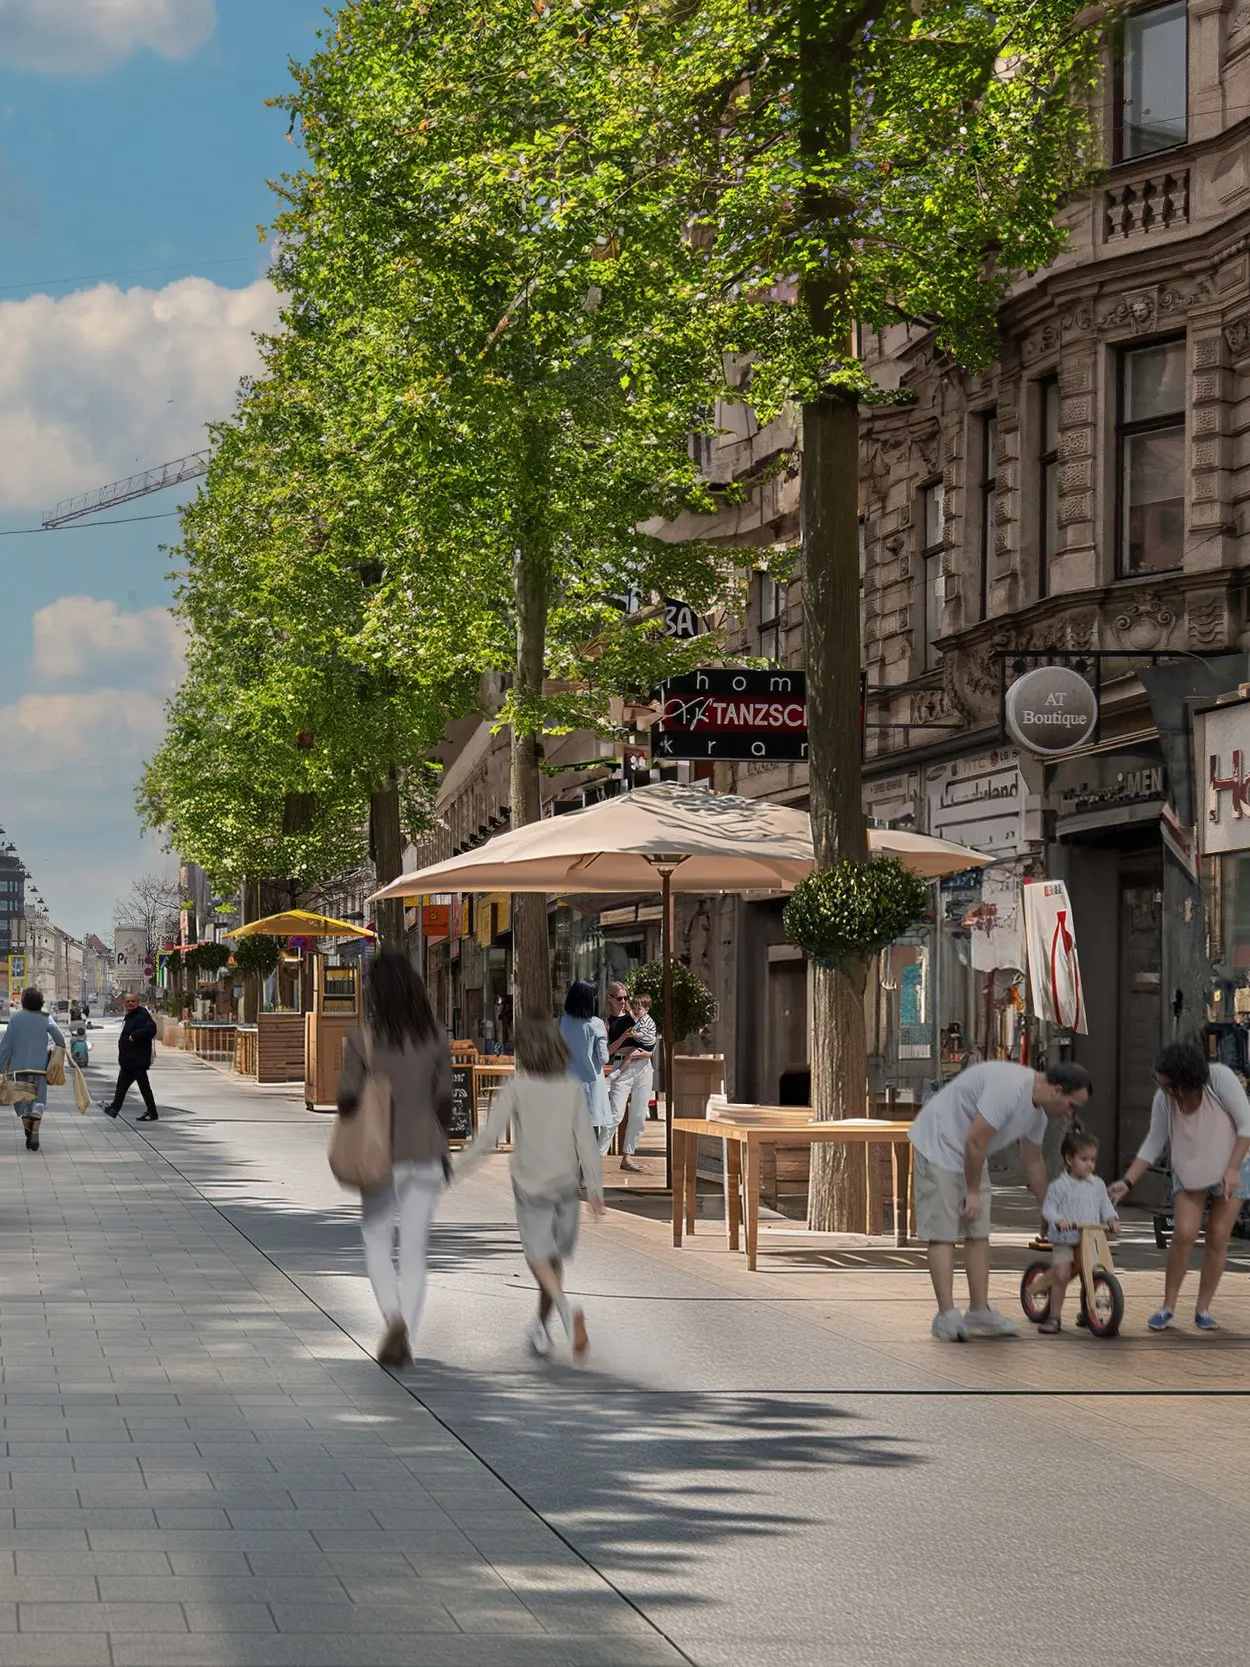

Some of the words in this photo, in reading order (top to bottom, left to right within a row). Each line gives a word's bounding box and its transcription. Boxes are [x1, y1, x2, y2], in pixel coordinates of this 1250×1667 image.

[1044, 692, 1067, 706] AT
[712, 702, 808, 727] TANZSC
[1022, 710, 1087, 728] Boutique
[1126, 766, 1162, 796] MEN
